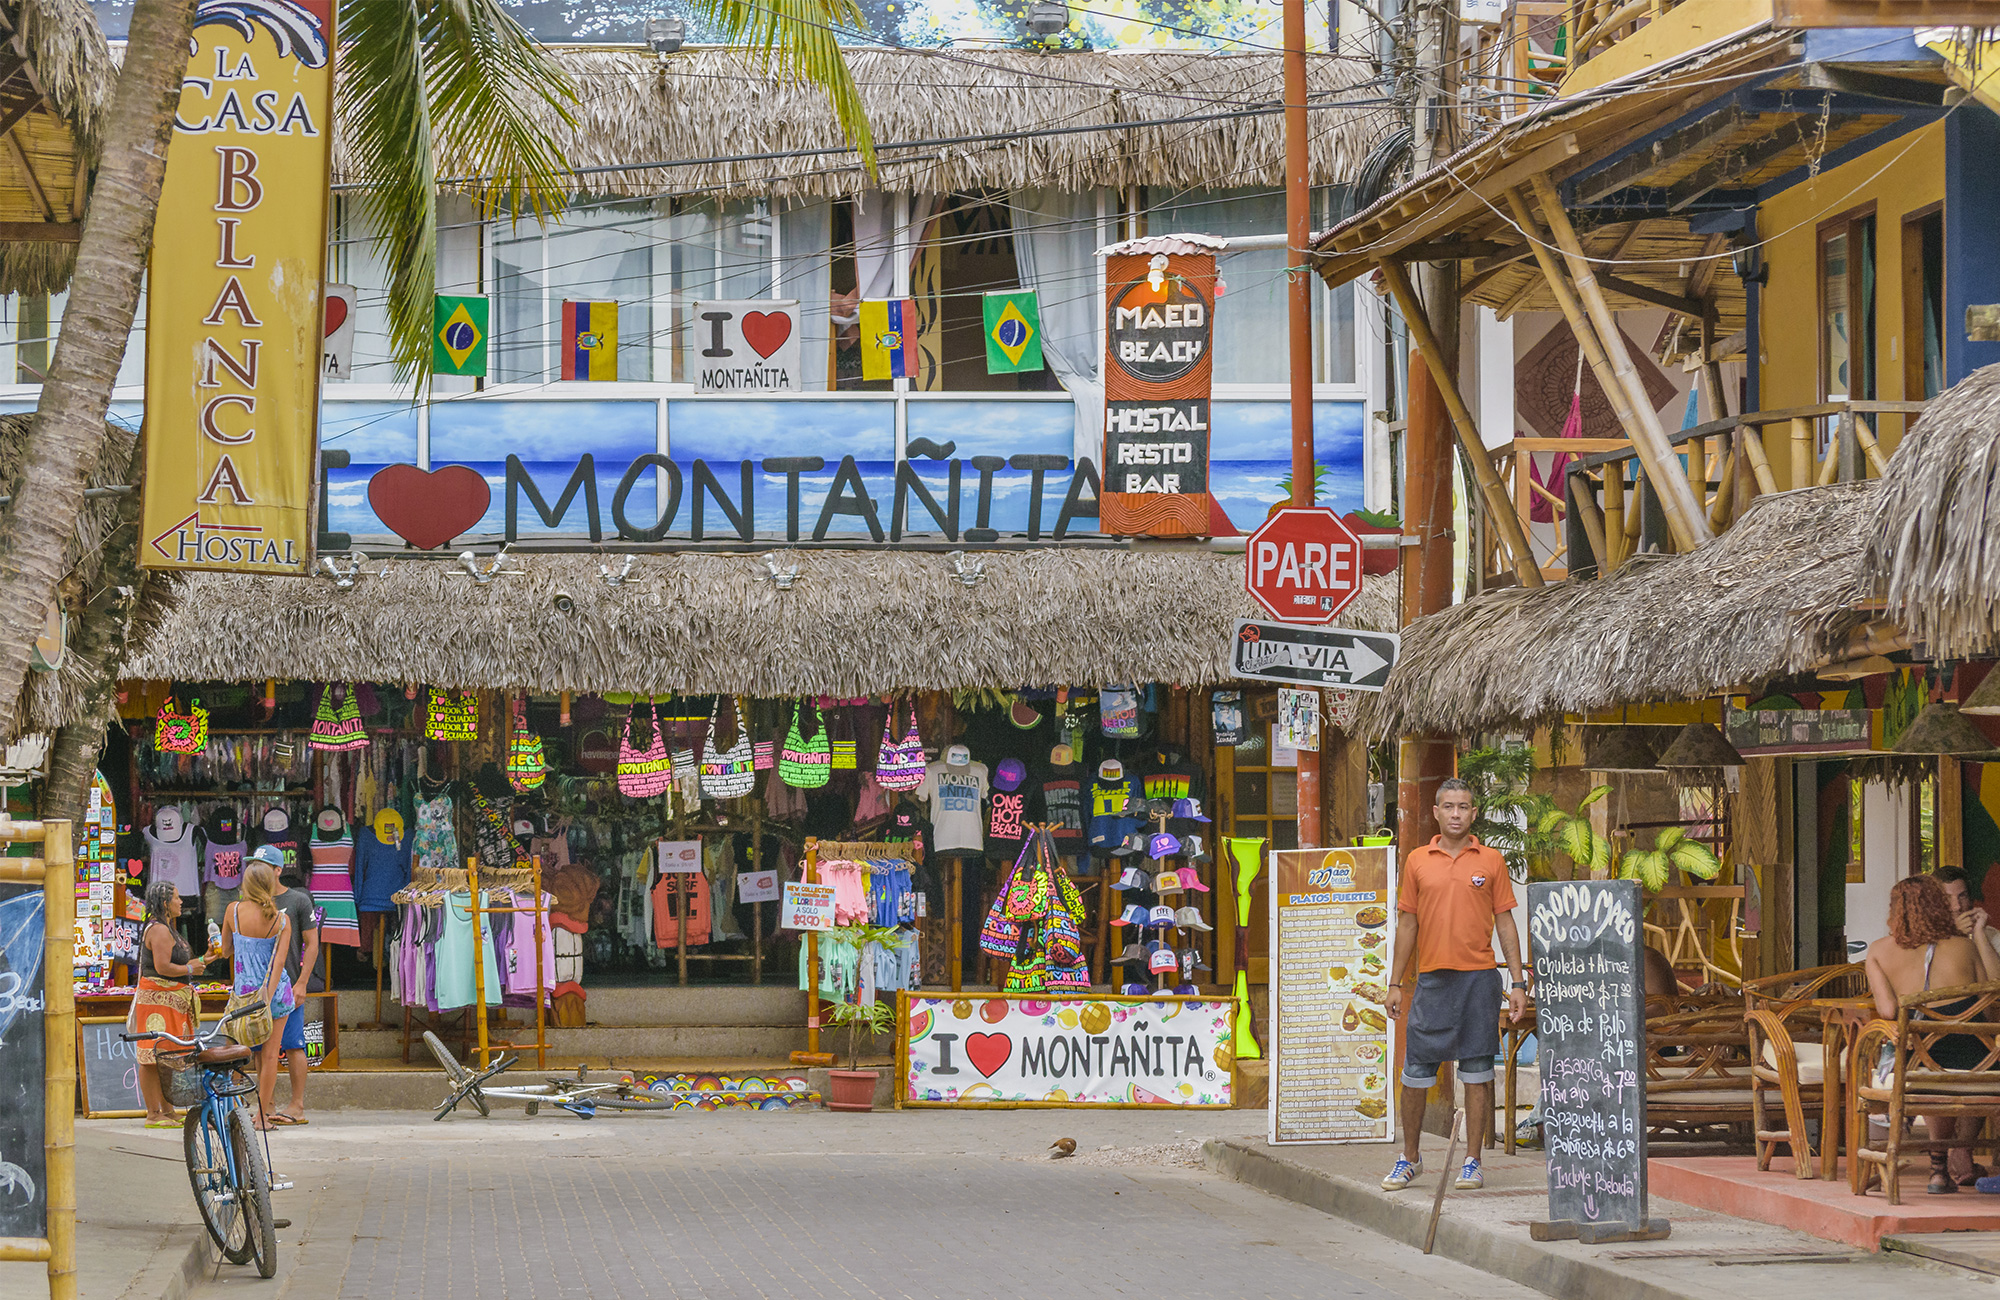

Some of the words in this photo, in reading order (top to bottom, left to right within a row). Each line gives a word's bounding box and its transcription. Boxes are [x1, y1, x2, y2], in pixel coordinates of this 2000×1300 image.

[214, 46, 256, 81] LA
[174, 78, 319, 138] CASA
[198, 145, 264, 506] BLANCA
[1116, 303, 1204, 330] MAEO
[702, 312, 733, 358] I
[1119, 339, 1202, 364] BEACH
[702, 362, 790, 390] MONTAÑITA
[1107, 406, 1207, 432] HOSTAL
[1117, 441, 1192, 466] RESTO
[505, 437, 1102, 545] MONTAÑITA
[1125, 472, 1180, 494] BAR
[178, 528, 300, 565] HOSTAL
[1257, 541, 1351, 590] PARE
[1304, 646, 1350, 670] VIA
[428, 704, 462, 714] ECUADOR
[878, 751, 925, 764] CUADOR
[939, 774, 979, 788] MONTA
[945, 798, 974, 812] ECU
[992, 793, 1024, 810] ONE
[991, 807, 1023, 824] HOT
[990, 822, 1022, 837] BEACH
[214, 851, 240, 866] SUMMER
[217, 864, 239, 878] NIGHTS
[667, 881, 698, 892] SRF
[801, 886, 836, 895] COLLECTION
[1290, 894, 1330, 904] PLATOS
[1332, 891, 1376, 903] FUERTES
[789, 897, 813, 907] COLORS
[802, 907, 819, 915] SOLO
[1530, 883, 1592, 954] PROMO
[1593, 889, 1635, 944] MAEO
[115, 927, 132, 951] $5
[1537, 952, 1585, 983] Chuleta
[1597, 952, 1630, 975] Arroz
[1540, 1007, 1574, 1041] Sopa
[1578, 1007, 1593, 1035] de
[1598, 1009, 1626, 1042] Pollo
[931, 1033, 960, 1075] I
[1020, 1021, 1204, 1079] MONTAÑITA
[1570, 1079, 1590, 1109] ajo
[1608, 1114, 1618, 1131] a
[1622, 1108, 1634, 1135] la
